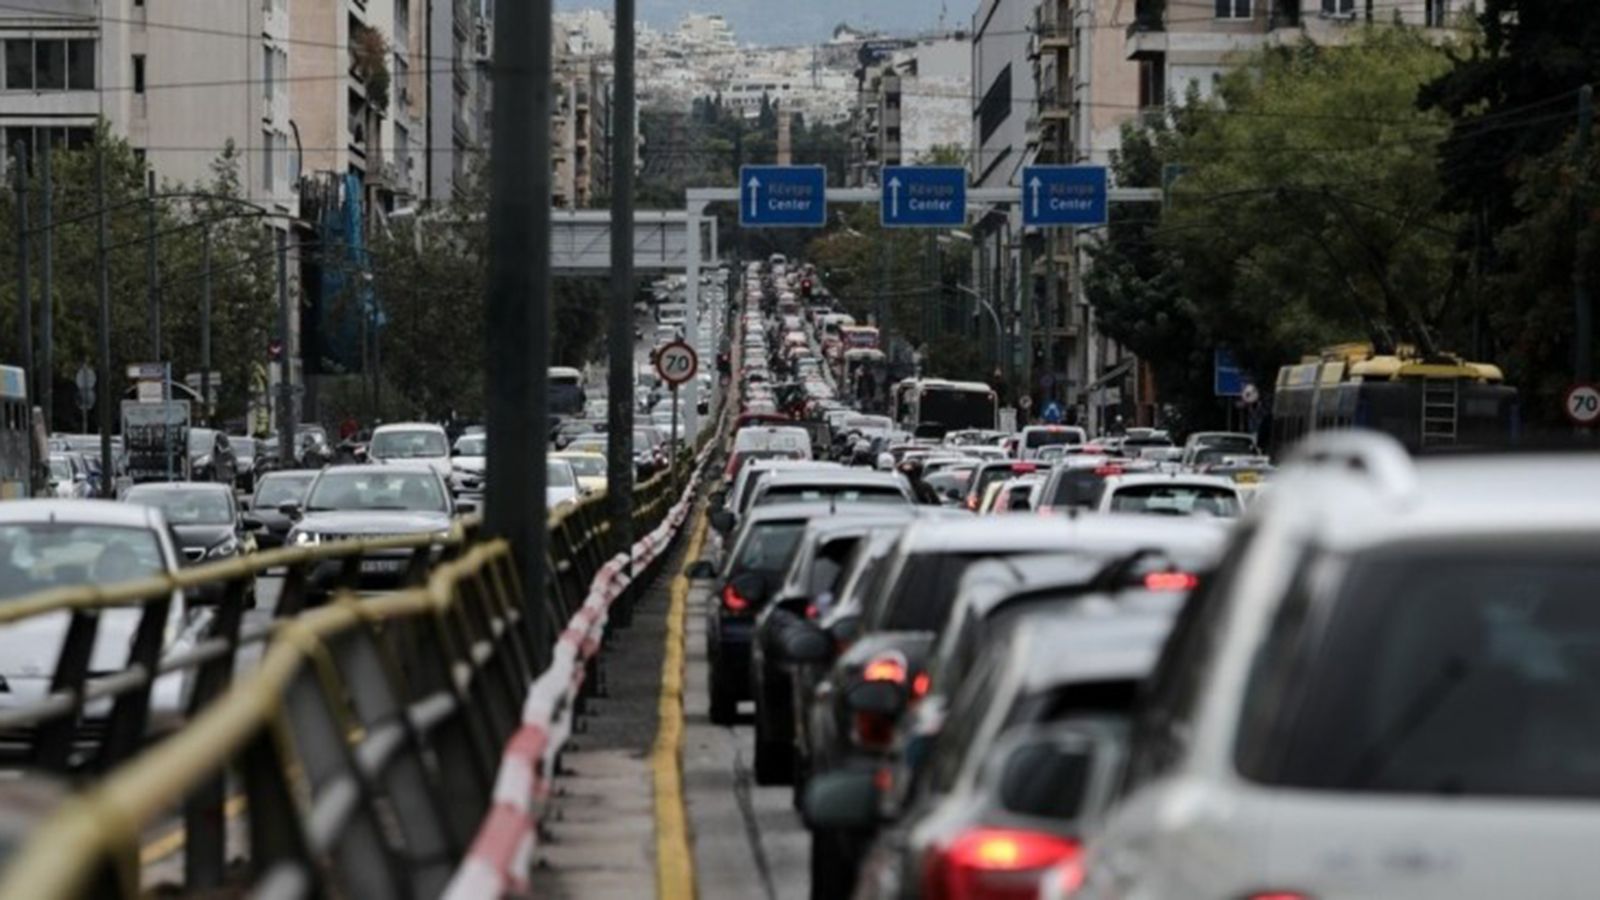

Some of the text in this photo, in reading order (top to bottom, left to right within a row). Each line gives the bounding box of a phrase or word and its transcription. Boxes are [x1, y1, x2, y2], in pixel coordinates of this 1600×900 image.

[768, 198, 812, 211] Center
[909, 198, 953, 211] Center
[1050, 198, 1093, 211] Center
[666, 355, 689, 371] 70
[1573, 395, 1598, 412] 70
